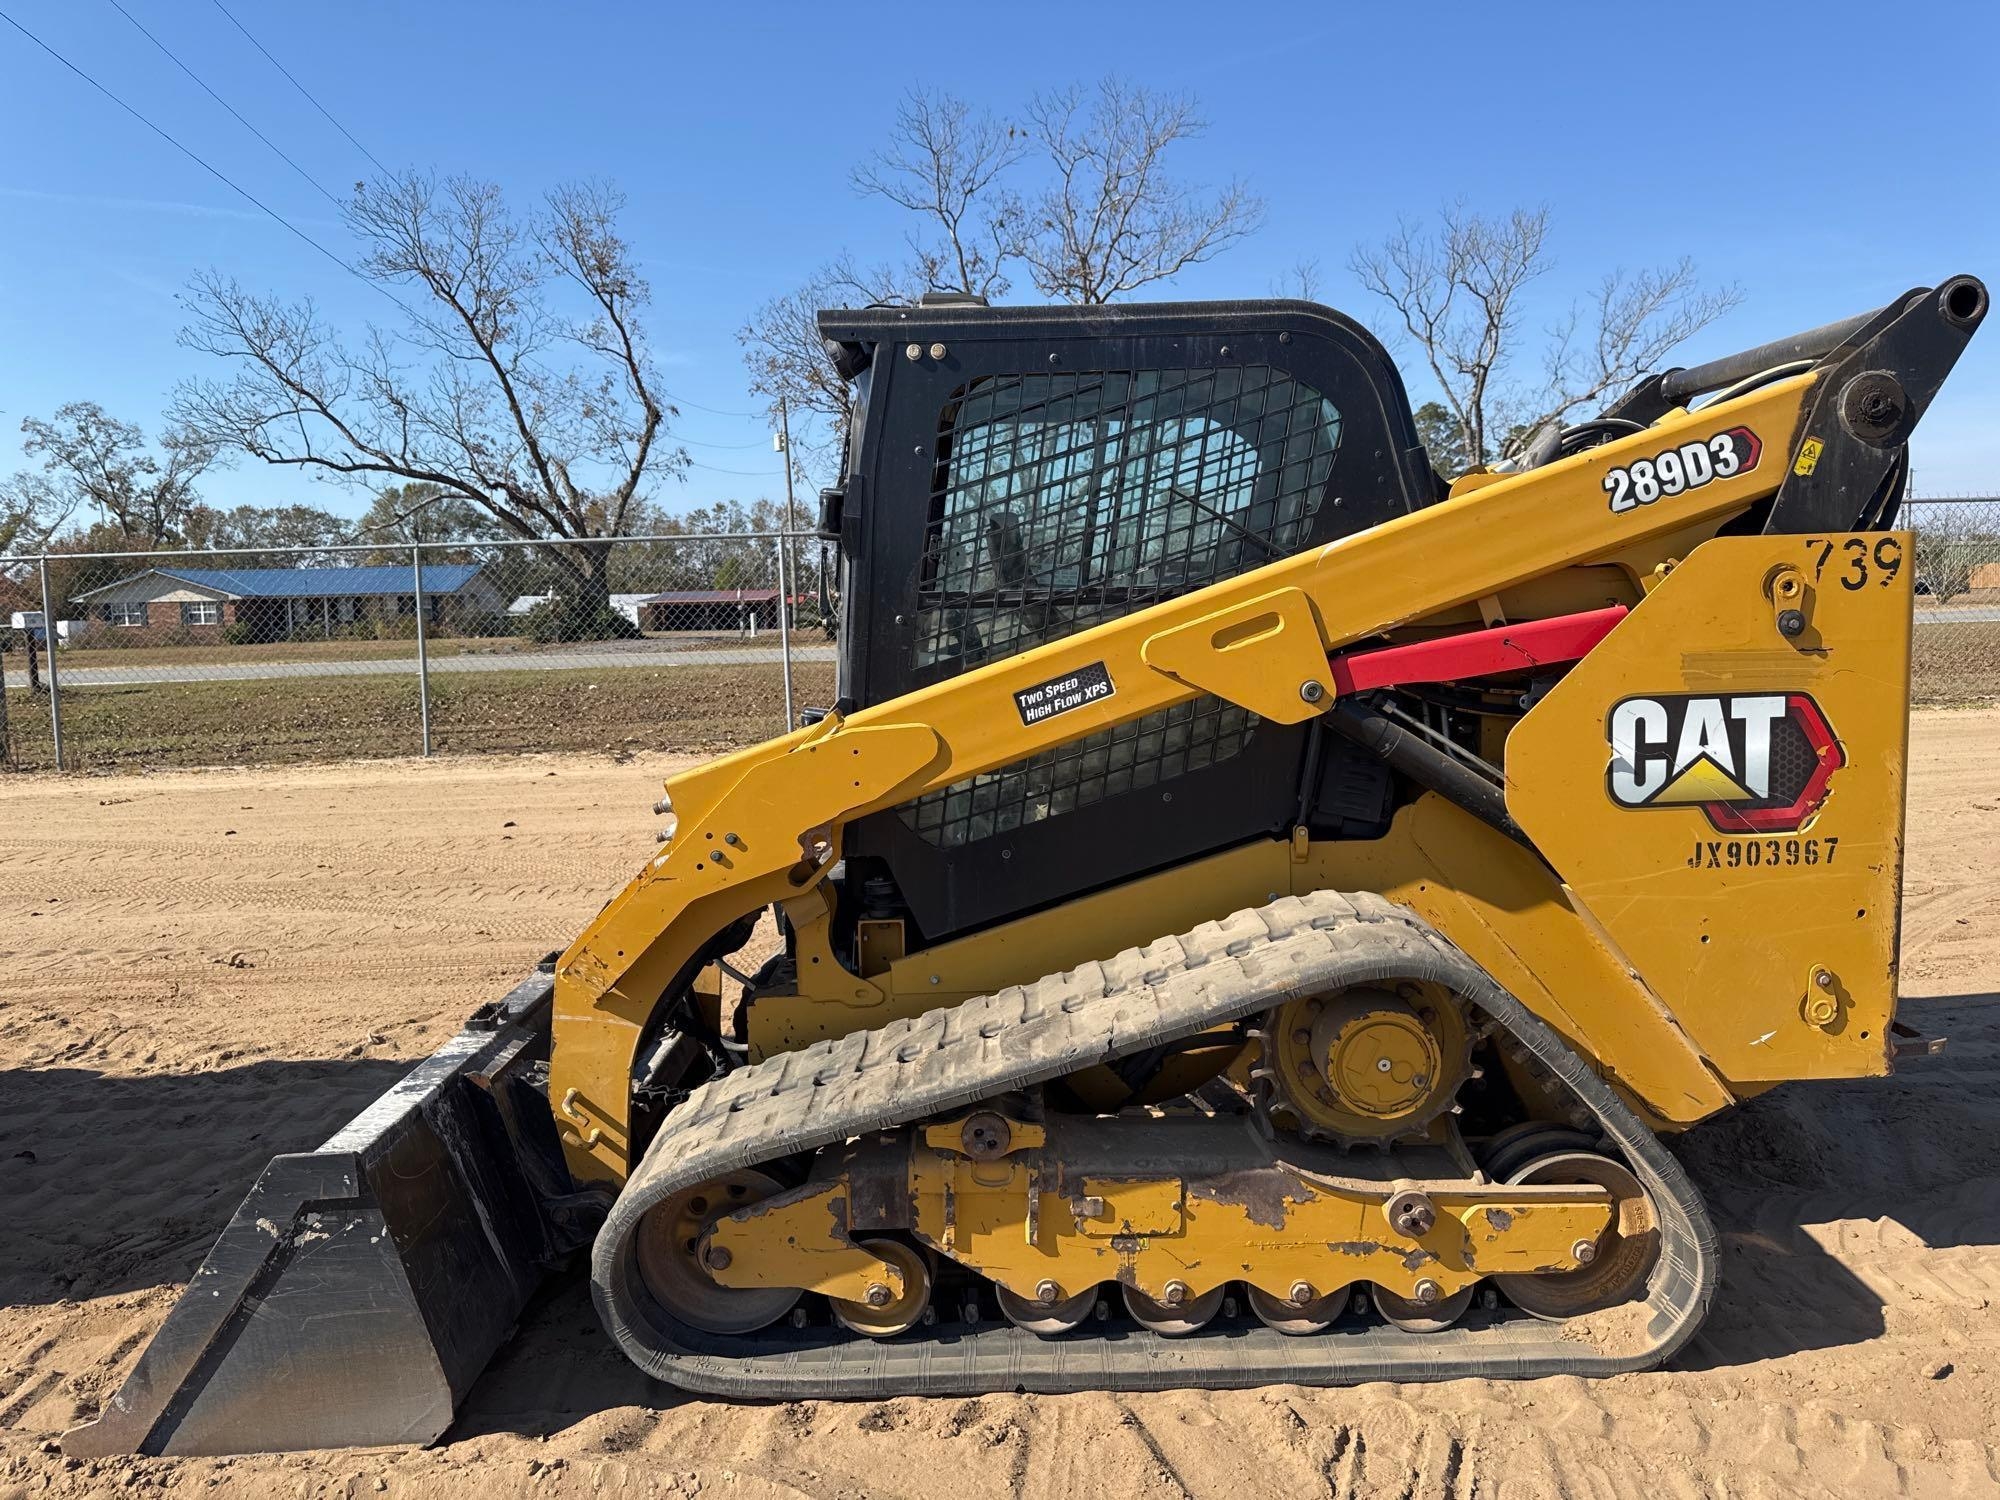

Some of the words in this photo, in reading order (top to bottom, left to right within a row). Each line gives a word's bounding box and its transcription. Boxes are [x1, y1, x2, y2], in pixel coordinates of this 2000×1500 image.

[1604, 434, 1739, 512] 289D3
[1806, 537, 1902, 591] 739
[1019, 691, 1043, 708] TWO
[1045, 678, 1078, 698] SPEED
[1026, 704, 1052, 722] HIGH
[1054, 692, 1082, 711] FLOW
[1085, 681, 1108, 700] XPS
[1612, 696, 1786, 804] CAT
[1687, 837, 1839, 869] JX903967
